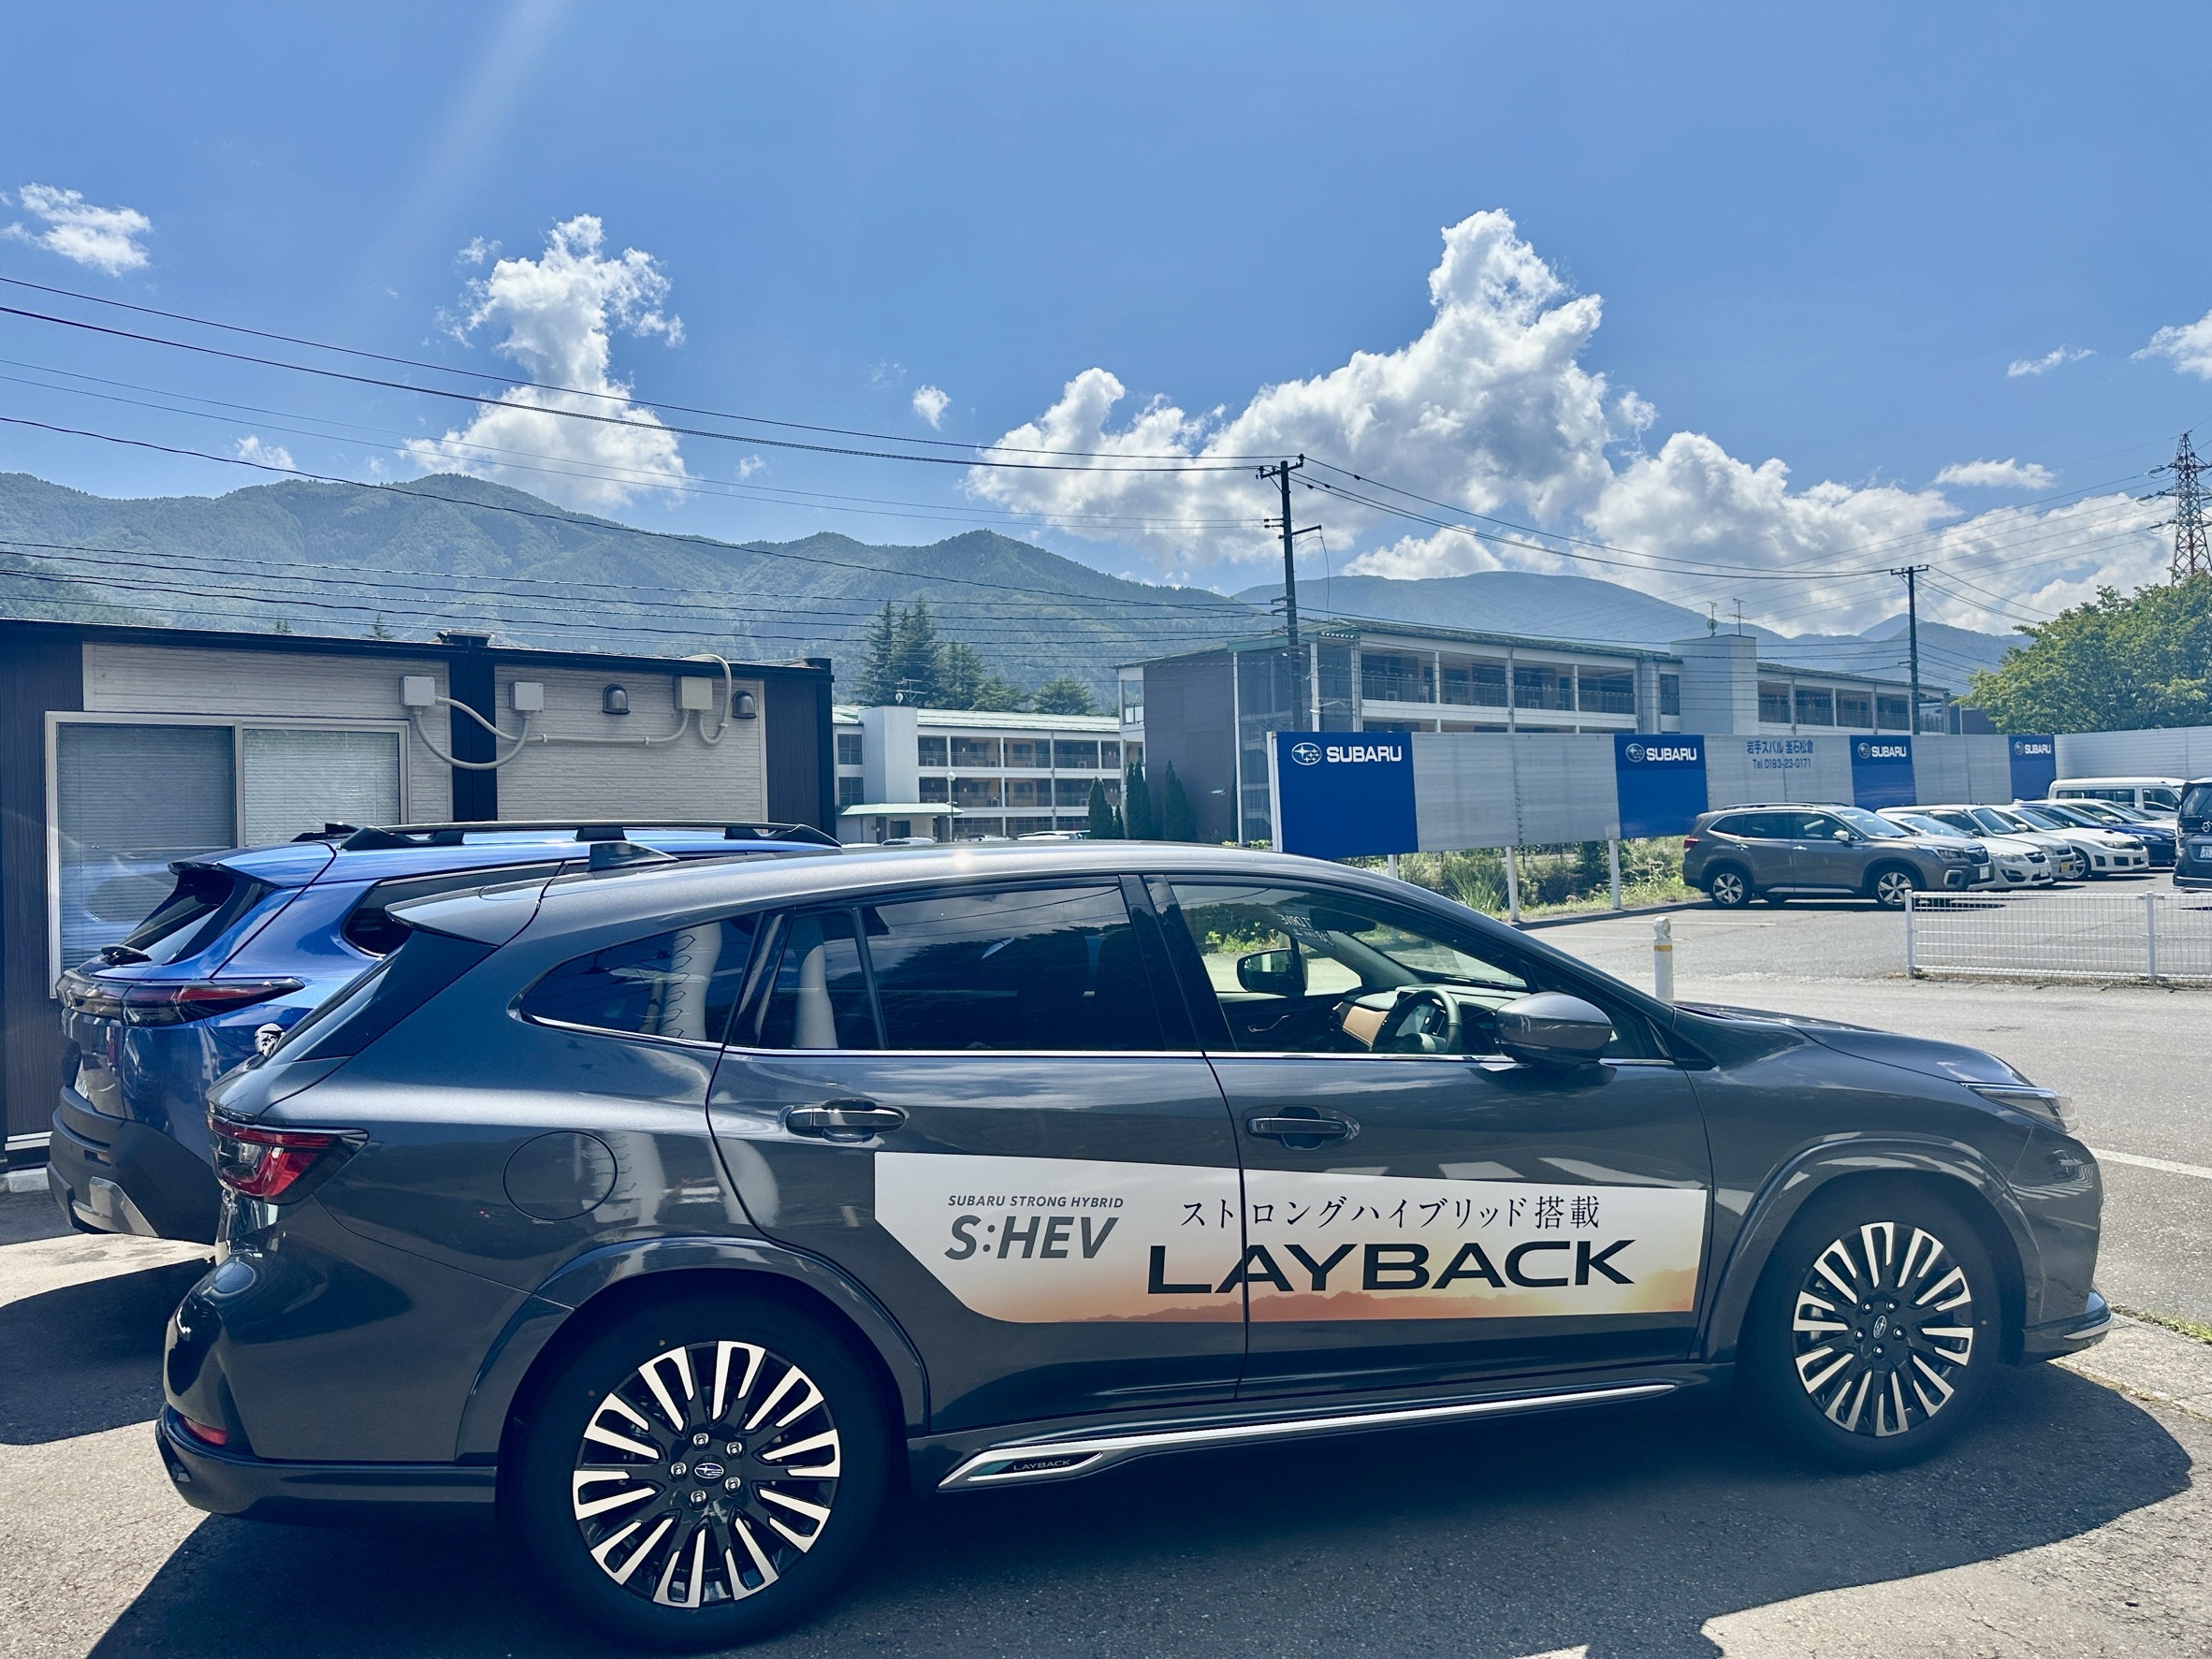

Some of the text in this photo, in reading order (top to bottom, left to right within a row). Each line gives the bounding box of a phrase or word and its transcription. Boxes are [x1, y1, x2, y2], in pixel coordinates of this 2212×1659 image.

[1746, 739, 1784, 754] 岩手スバル
[1871, 746, 1907, 758] SUBARU
[2024, 743, 2051, 754] SUBARU
[1326, 746, 1402, 763] SUBARU
[1646, 748, 1697, 762] SUBARU
[1753, 758, 1812, 769] Tel 0193-23-0171
[948, 1195, 1124, 1209] SUBARU STRONG HYBRID
[1180, 1195, 1601, 1230] ストロングハイブリッド搭載
[944, 1214, 1120, 1260] S:HEV
[1146, 1239, 1637, 1295] LAYBACK
[1013, 1459, 1070, 1472] LAYBACK
